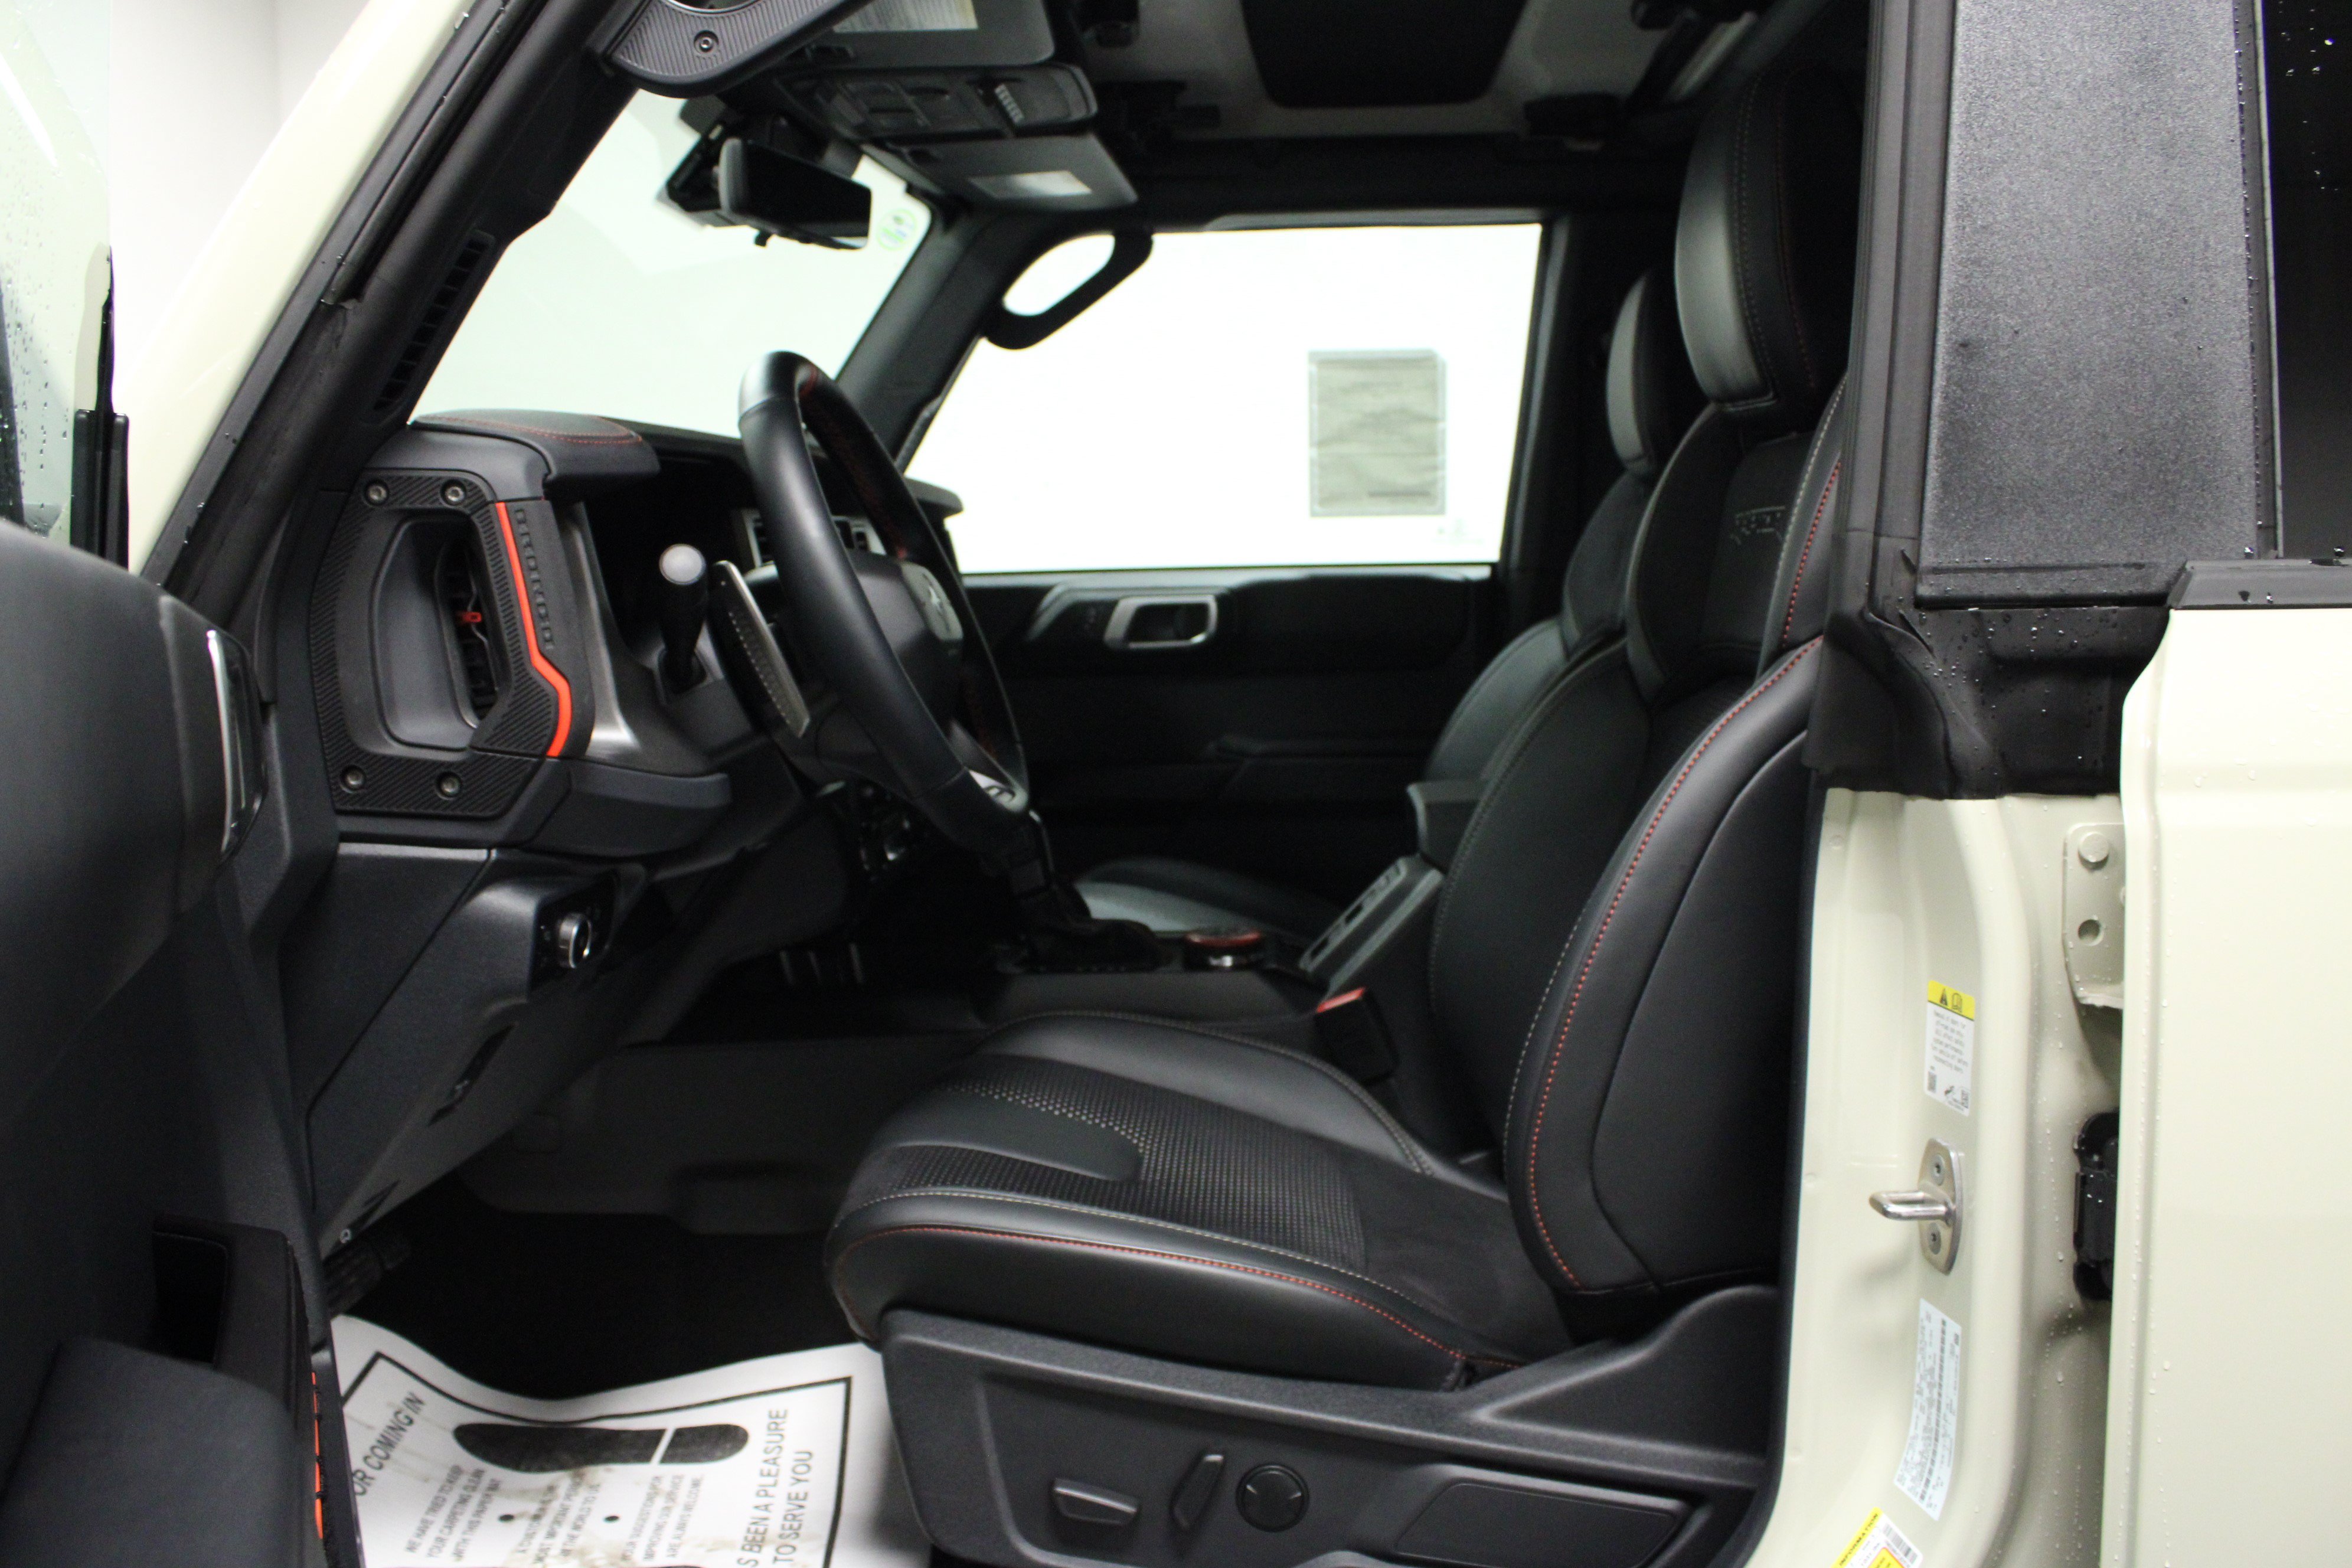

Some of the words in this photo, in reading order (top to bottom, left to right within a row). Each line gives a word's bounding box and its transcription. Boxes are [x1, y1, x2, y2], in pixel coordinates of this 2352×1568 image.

[403, 1391, 424, 1415] IN
[363, 1408, 414, 1471] COMING
[754, 1409, 788, 1498] PLEASURE
[352, 1469, 375, 1497] OR
[790, 1451, 814, 1487] YOU
[753, 1502, 775, 1513] A
[778, 1492, 808, 1540] SERVE
[740, 1516, 770, 1554] BEEN
[772, 1544, 796, 1564] TO
